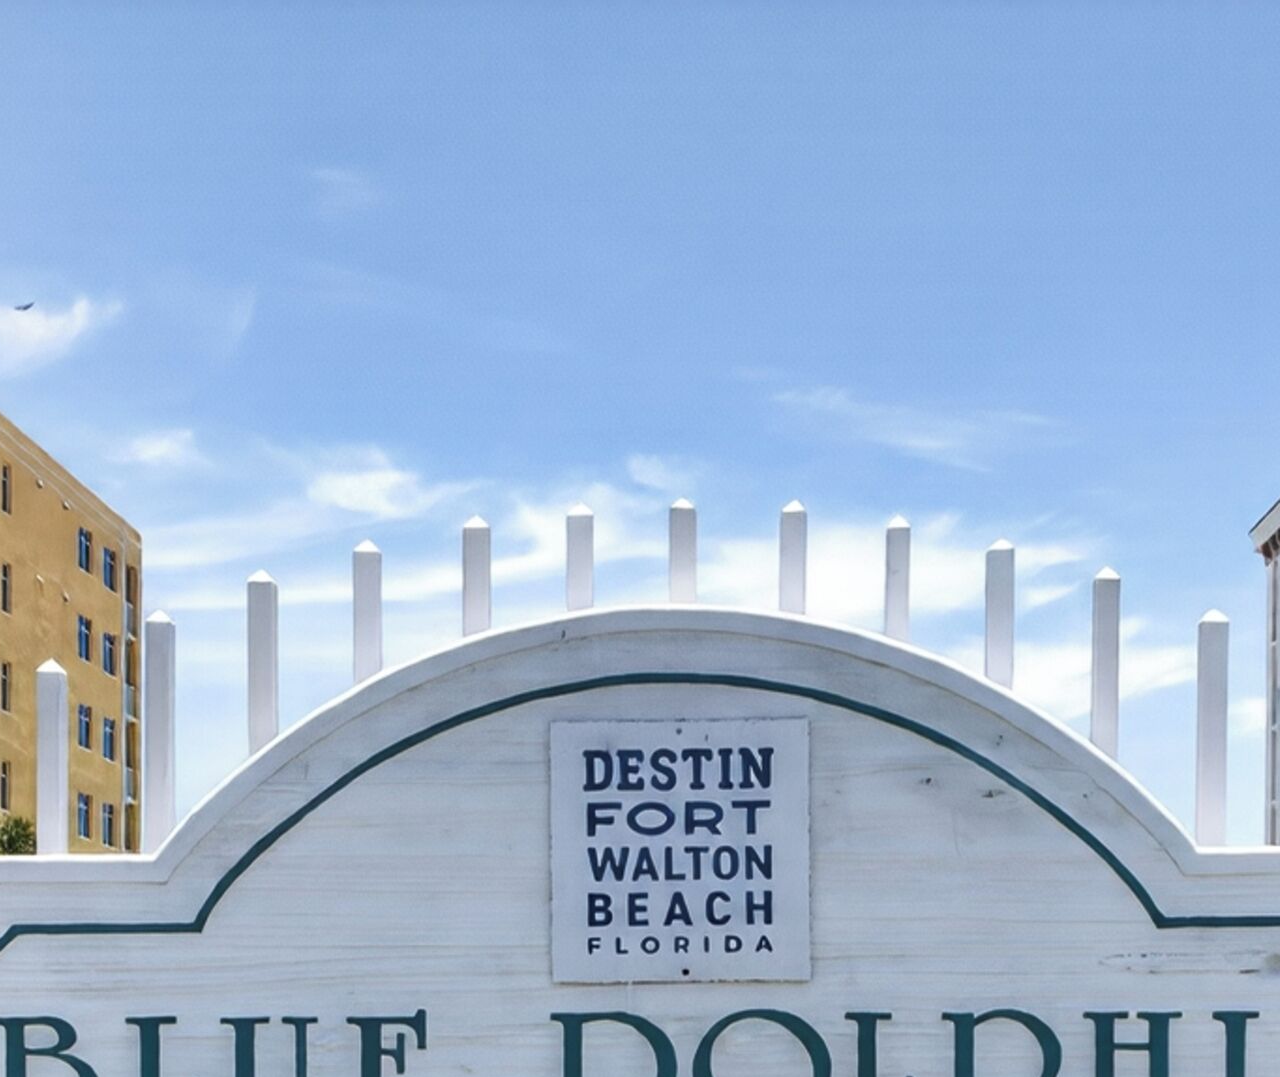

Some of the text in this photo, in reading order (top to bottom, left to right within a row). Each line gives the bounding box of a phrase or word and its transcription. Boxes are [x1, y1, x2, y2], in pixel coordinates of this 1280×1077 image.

[583, 747, 774, 792] DESTIN
[587, 800, 771, 837] FORT
[587, 845, 772, 882] WALTON
[588, 891, 772, 927] BEACH
[588, 935, 773, 955] FLORIDA
